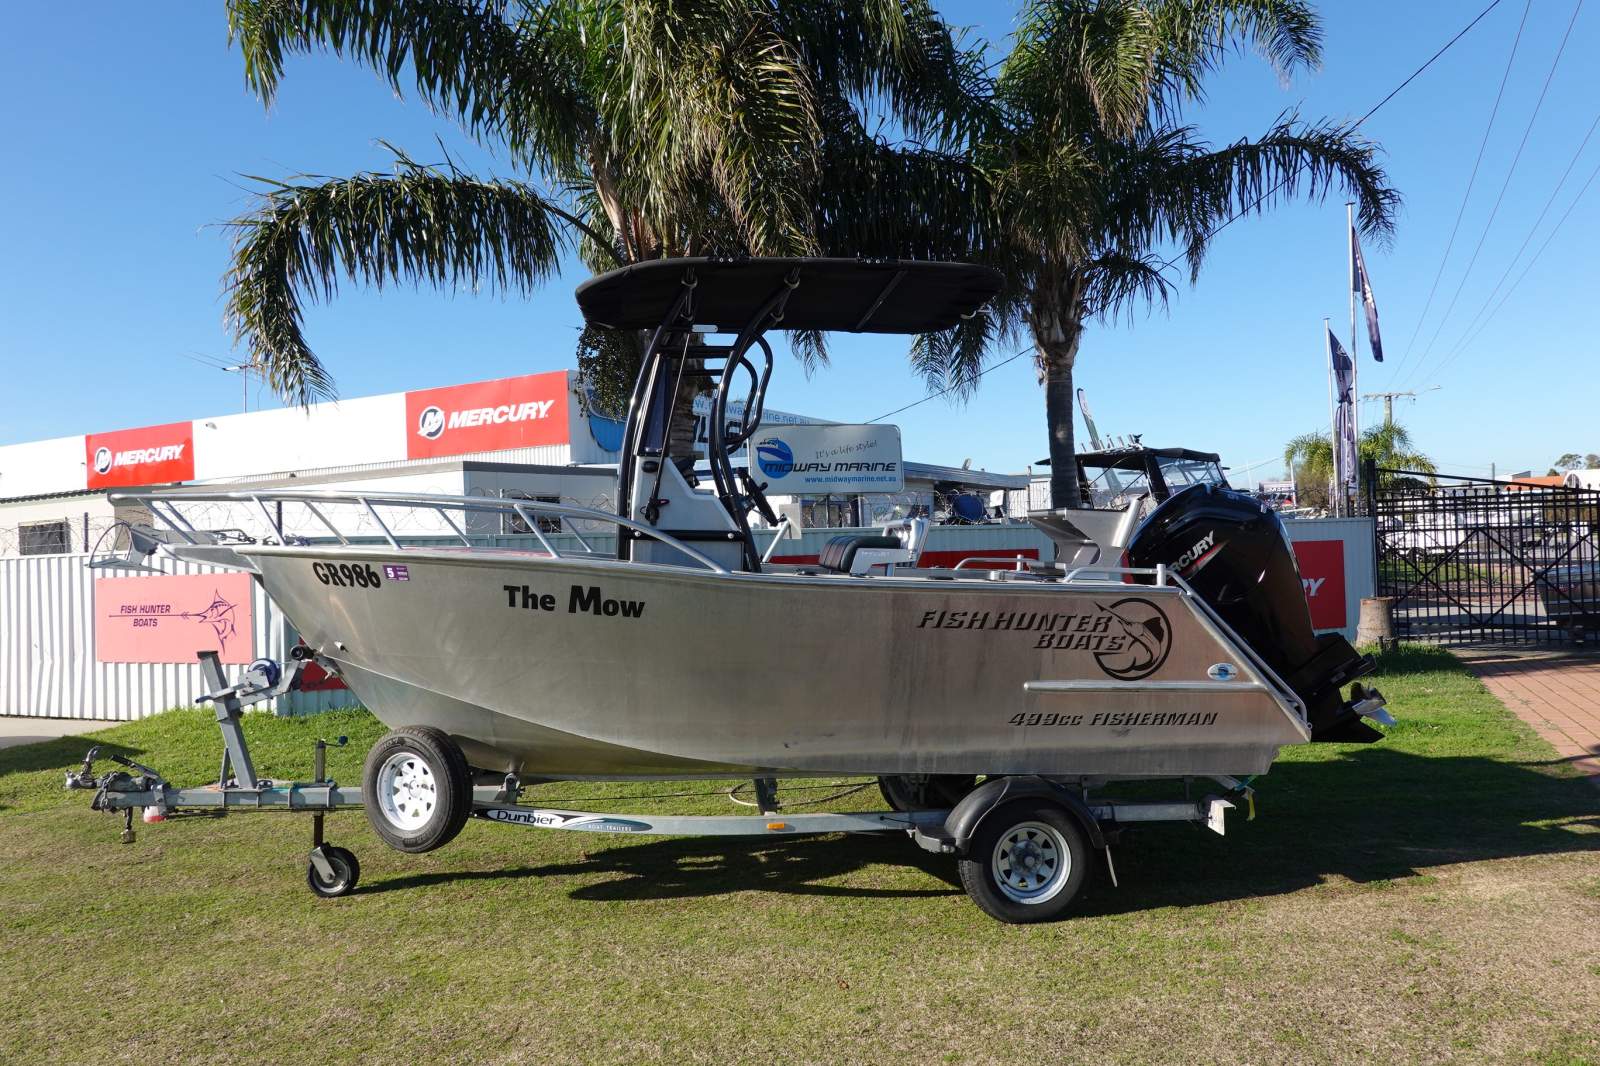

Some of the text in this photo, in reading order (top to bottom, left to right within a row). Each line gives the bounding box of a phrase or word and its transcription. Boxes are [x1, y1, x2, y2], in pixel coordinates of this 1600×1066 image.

[447, 399, 555, 429] MERCURY
[113, 444, 186, 467] MERCURY
[764, 462, 897, 473] MIDWAY MARINE
[804, 475, 897, 484] www.midwaymarine.net.au
[1169, 529, 1215, 573] RCURY
[312, 561, 382, 589] GR986
[386, 567, 395, 578] 5
[120, 604, 171, 614] FISH HUNTER
[503, 584, 646, 618] The Mow
[133, 618, 158, 627] BOATS
[916, 609, 1113, 633] FISH HUNTER
[1033, 632, 1128, 651] BOATS
[1089, 711, 1219, 726] FISHERMAN
[496, 810, 556, 825] Dunbier
